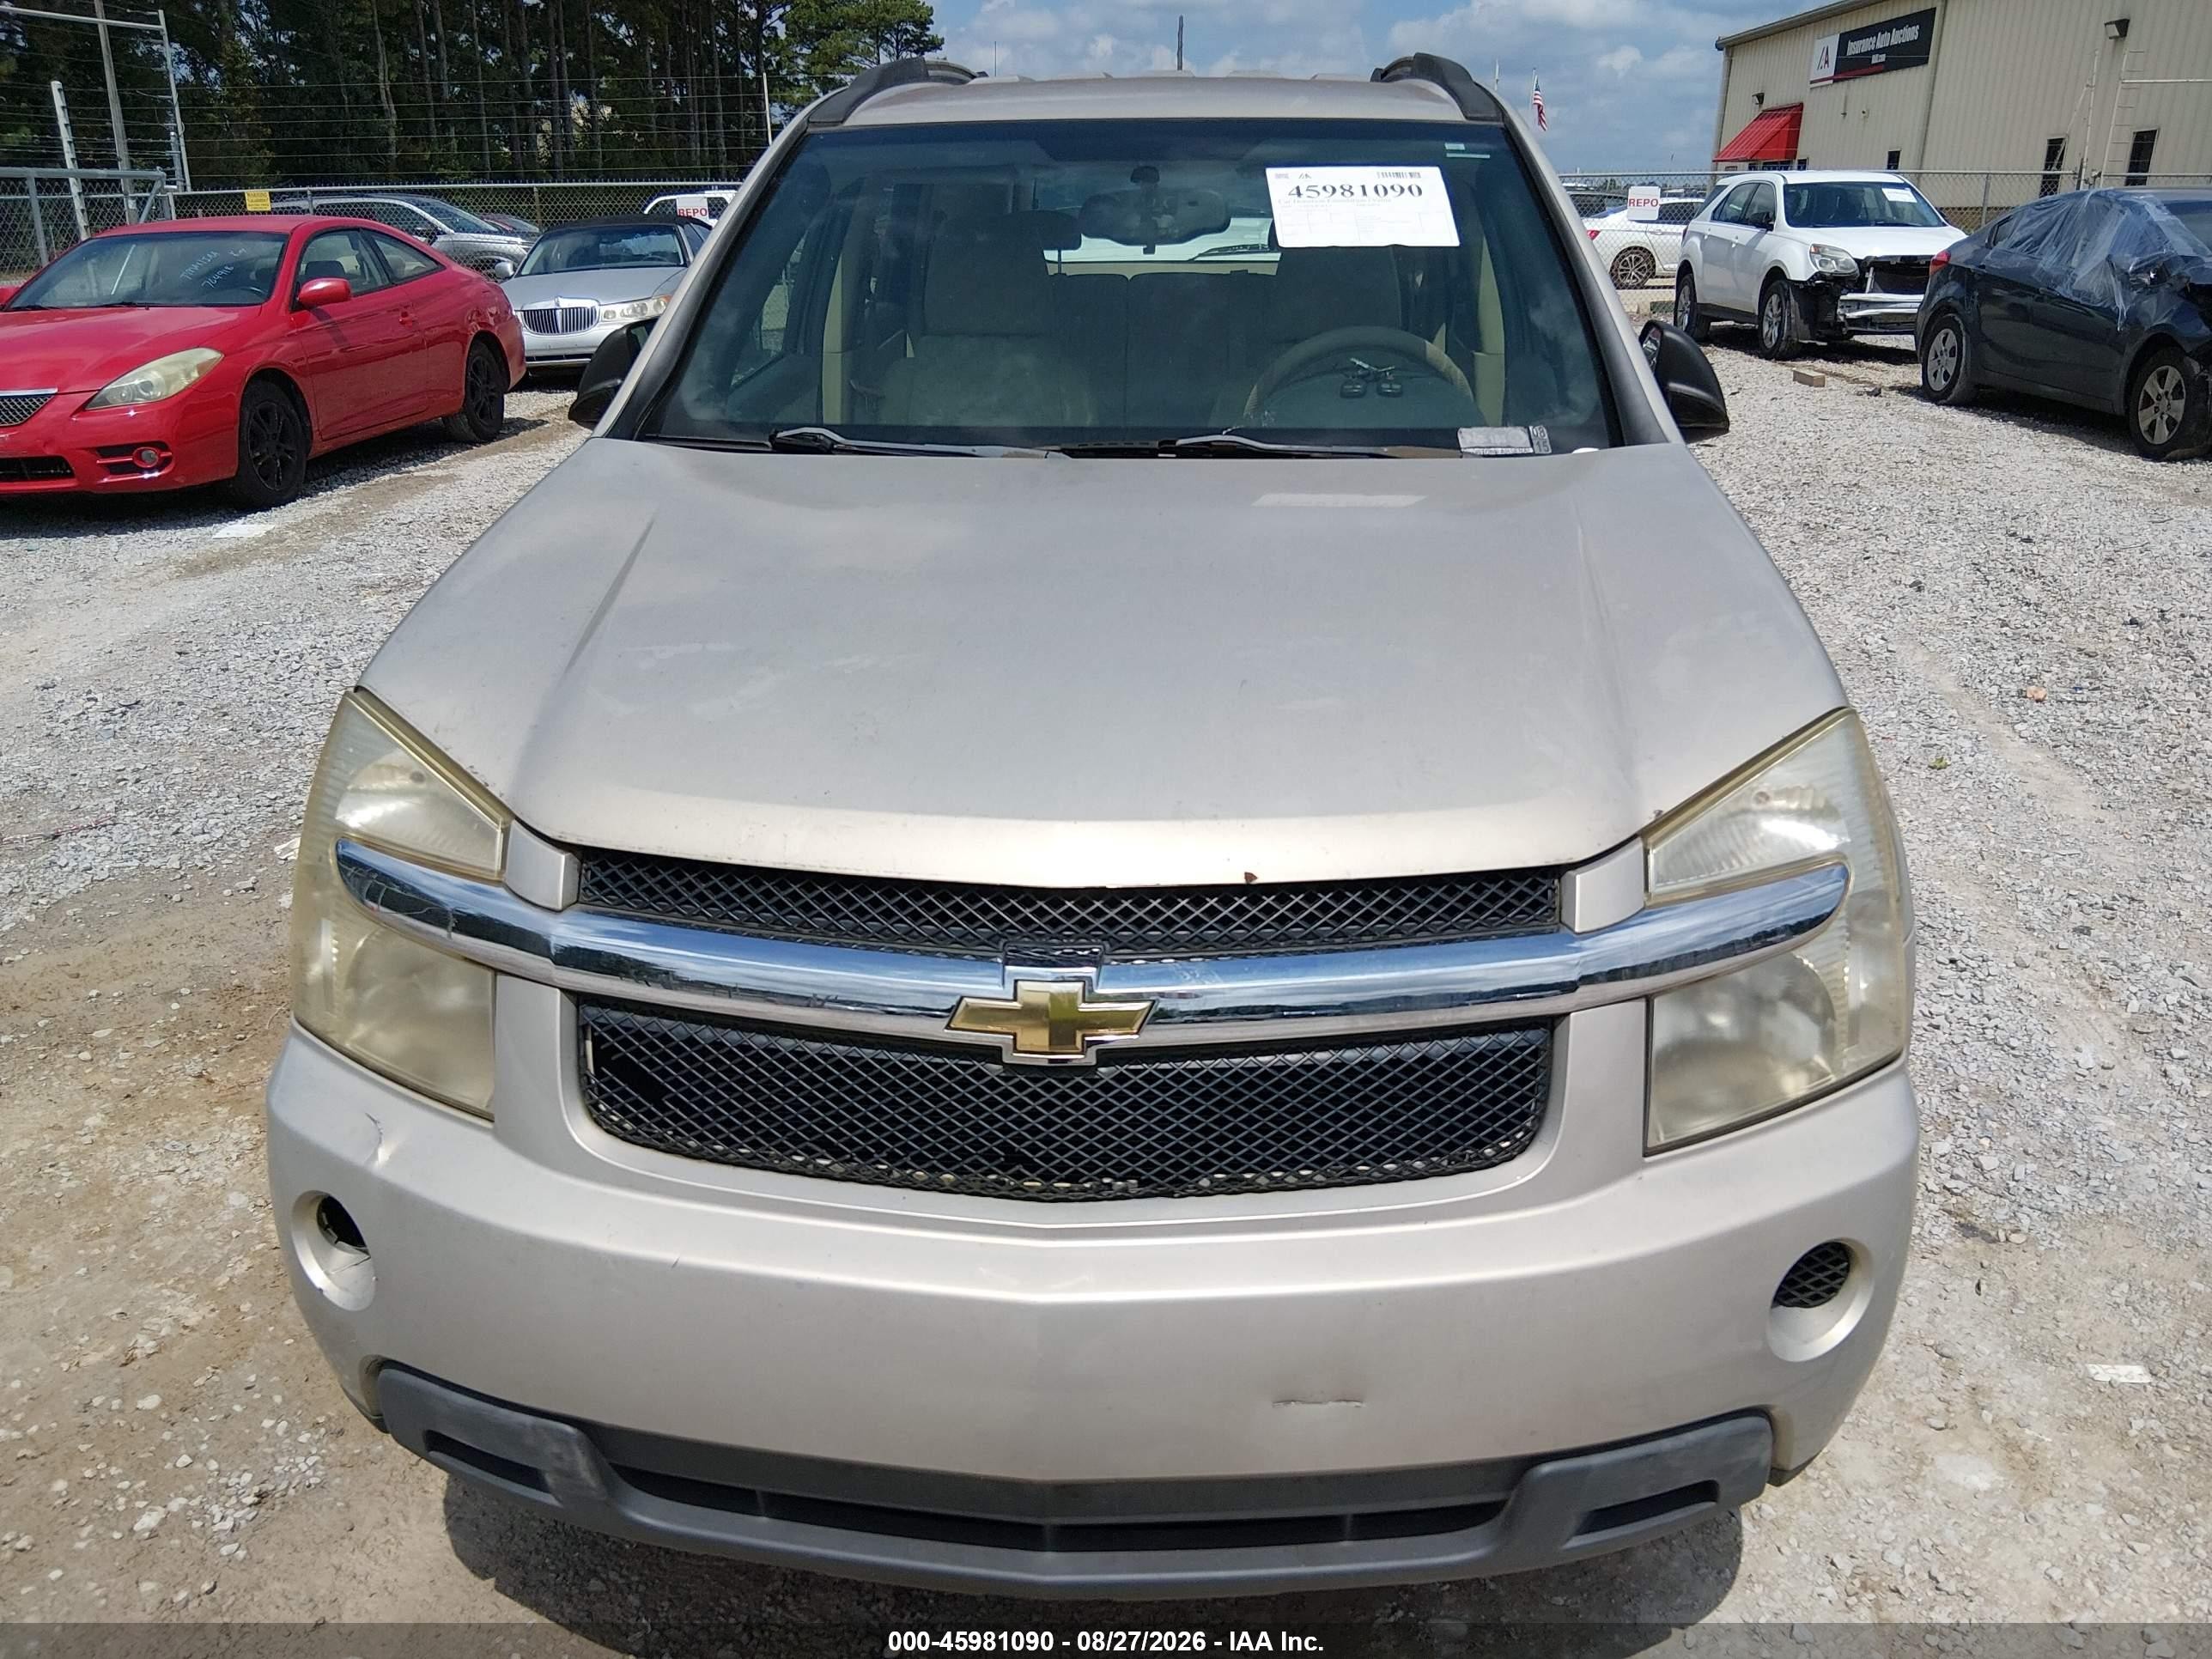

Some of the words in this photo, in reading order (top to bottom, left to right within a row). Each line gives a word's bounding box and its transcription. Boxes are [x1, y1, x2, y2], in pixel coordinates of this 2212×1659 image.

[1846, 36, 1876, 56] Insurance
[1875, 31, 1891, 50] Auto
[1890, 24, 1920, 46] Auctions
[1288, 183, 1423, 198] 45981090
[1628, 198, 1659, 207] REPO
[678, 208, 708, 217] REPO
[1535, 440, 1549, 453] 15
